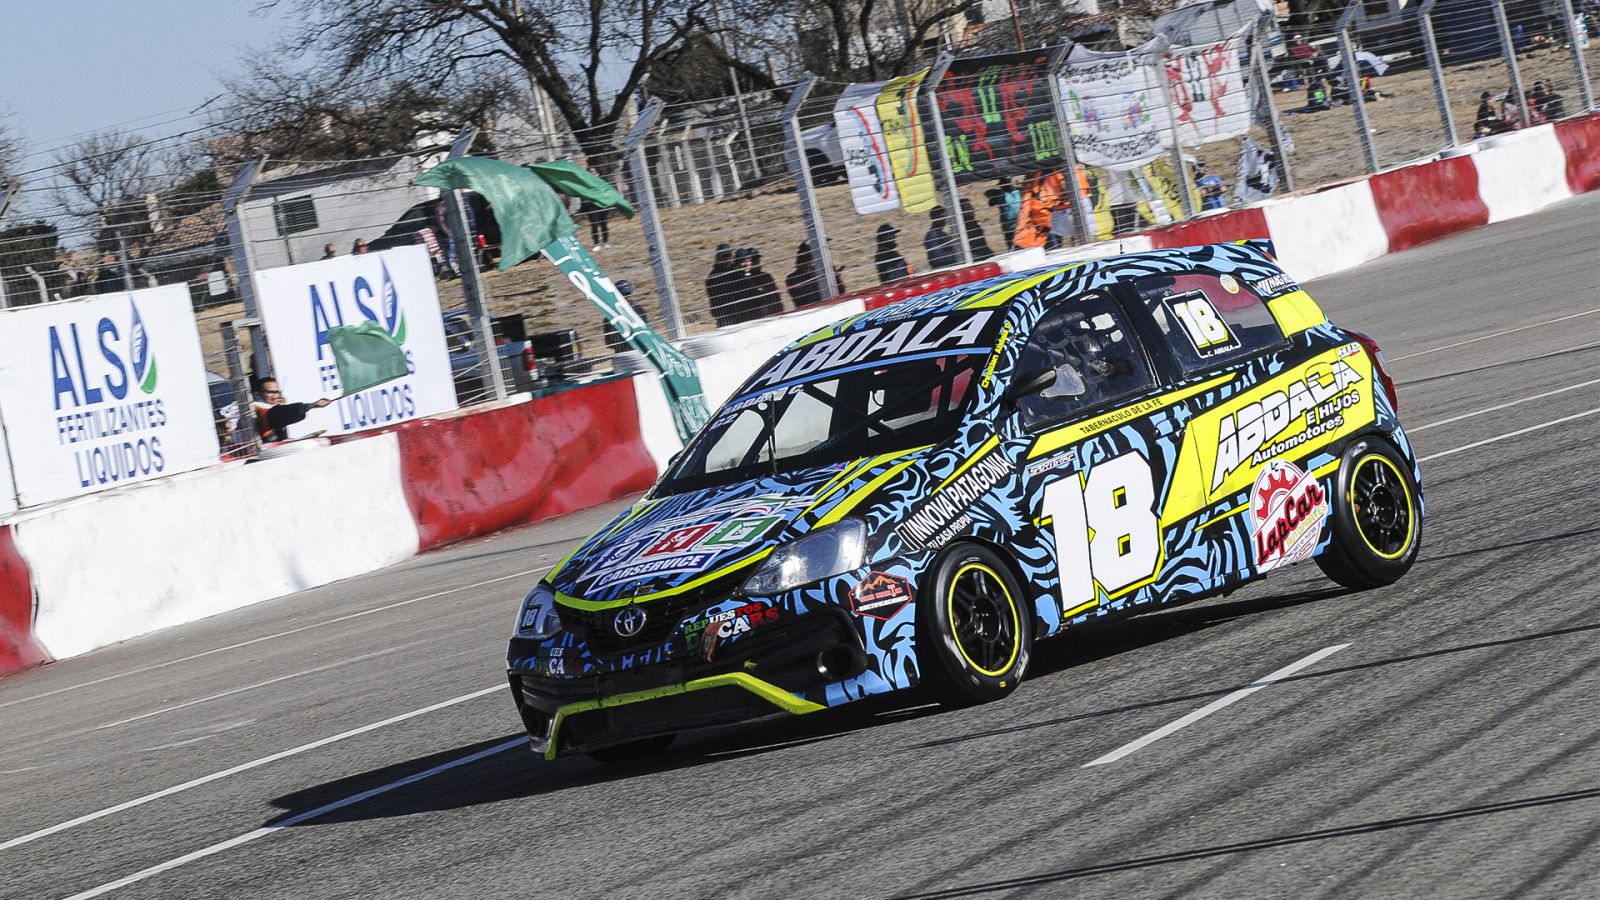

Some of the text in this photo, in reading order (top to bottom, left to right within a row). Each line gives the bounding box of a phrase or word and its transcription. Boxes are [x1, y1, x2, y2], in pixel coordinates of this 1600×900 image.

[1173, 298, 1229, 348] 18
[49, 316, 128, 410] ALS
[745, 310, 994, 393] ABDALA
[57, 398, 168, 446] FERTILIZANTES
[338, 383, 416, 431] LIQUIDOS
[1079, 398, 1164, 435] TABERNACULO DE LA FE
[1305, 391, 1361, 427] E HIJOS
[74, 434, 165, 488] LIQUIDOS
[1250, 416, 1345, 466] Automotores
[937, 530, 954, 545] CASA
[951, 513, 973, 536] PROPIA
[1039, 450, 1163, 614] 18
[1257, 484, 1324, 567] LapCar
[600, 554, 706, 586] CARSERVICE
[522, 608, 538, 627] 18
[685, 602, 762, 635] REPUESTOS
[718, 606, 779, 639] CARS
